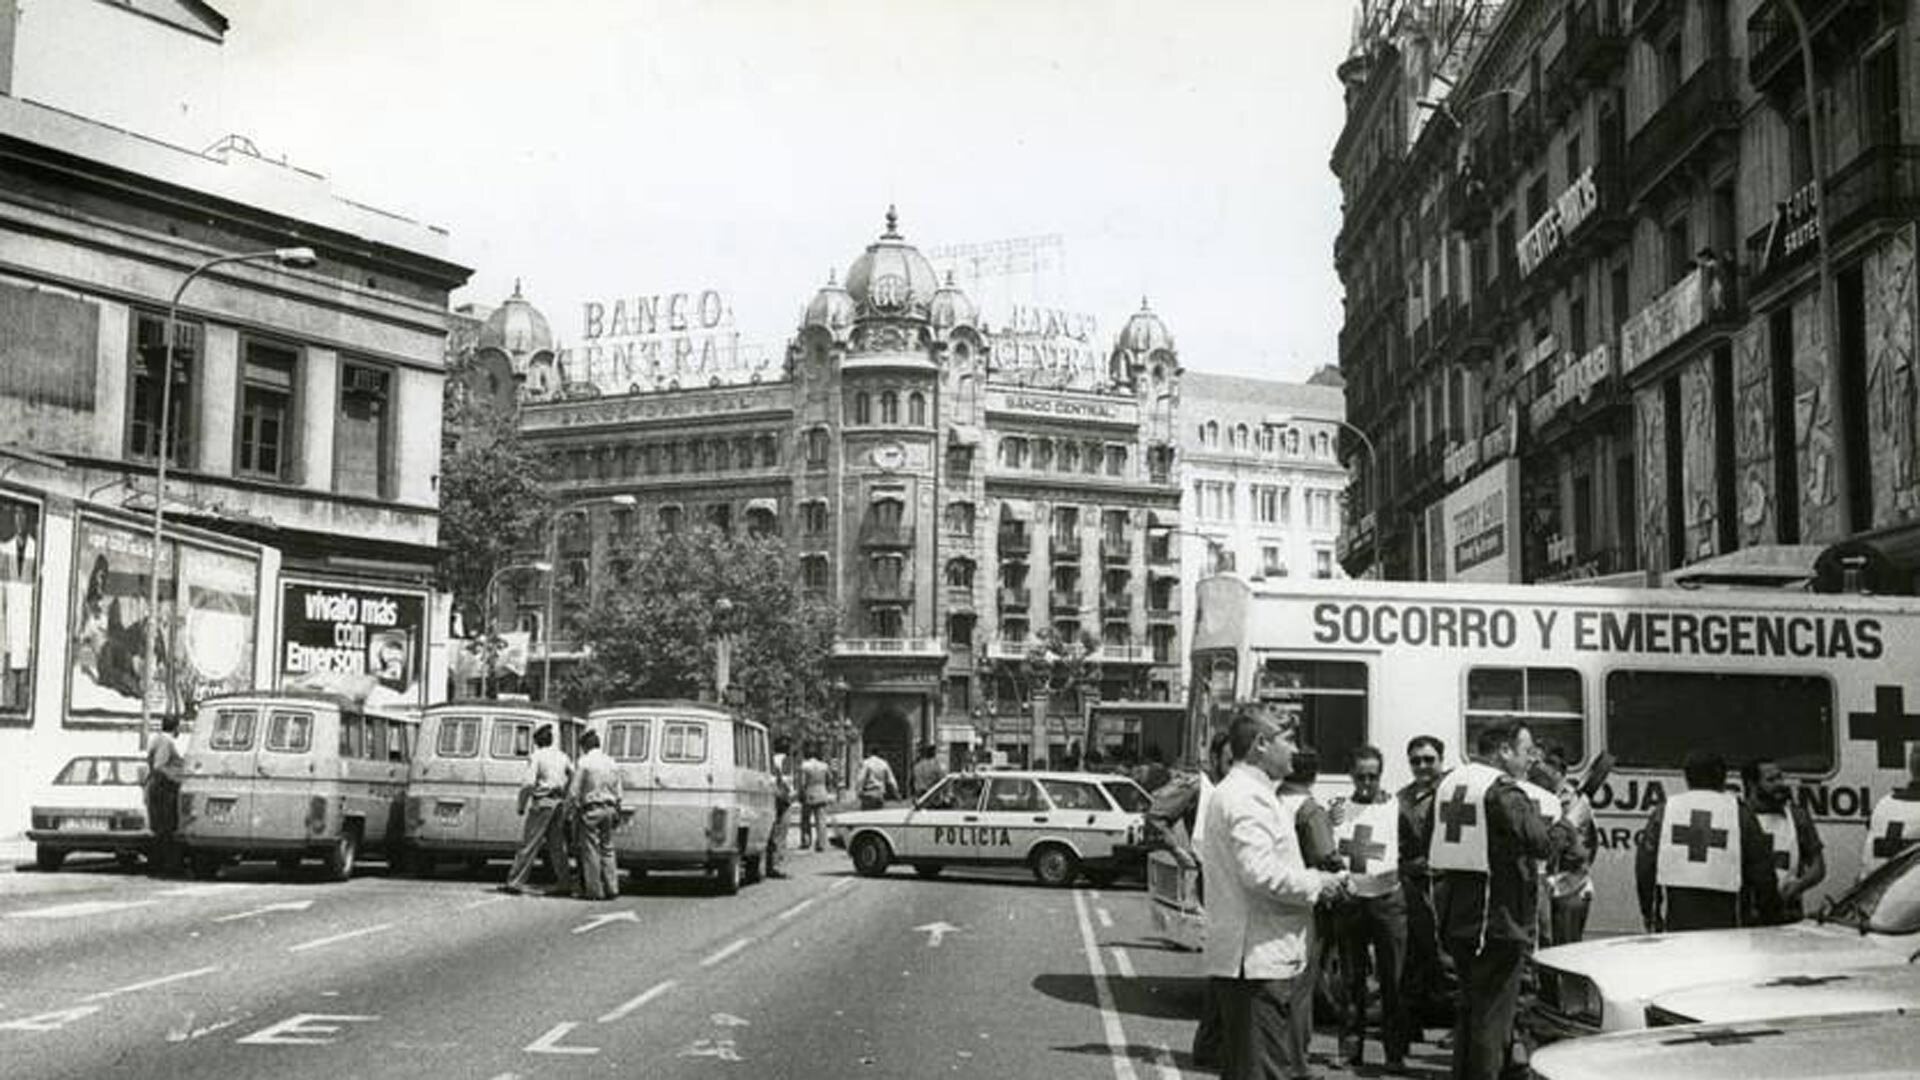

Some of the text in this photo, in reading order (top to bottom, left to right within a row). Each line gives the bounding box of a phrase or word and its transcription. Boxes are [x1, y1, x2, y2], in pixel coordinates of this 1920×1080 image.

[583, 289, 722, 340] BANCO
[562, 335, 746, 384] ENTRAL
[1006, 396, 1117, 420] BANCO CENTRAL
[361, 597, 398, 625] más
[335, 622, 366, 648] con
[1313, 603, 1884, 660] SOCORRO Y EMERGENCIAS
[287, 641, 366, 676] Emerson
[935, 826, 1011, 846] POLICIA
